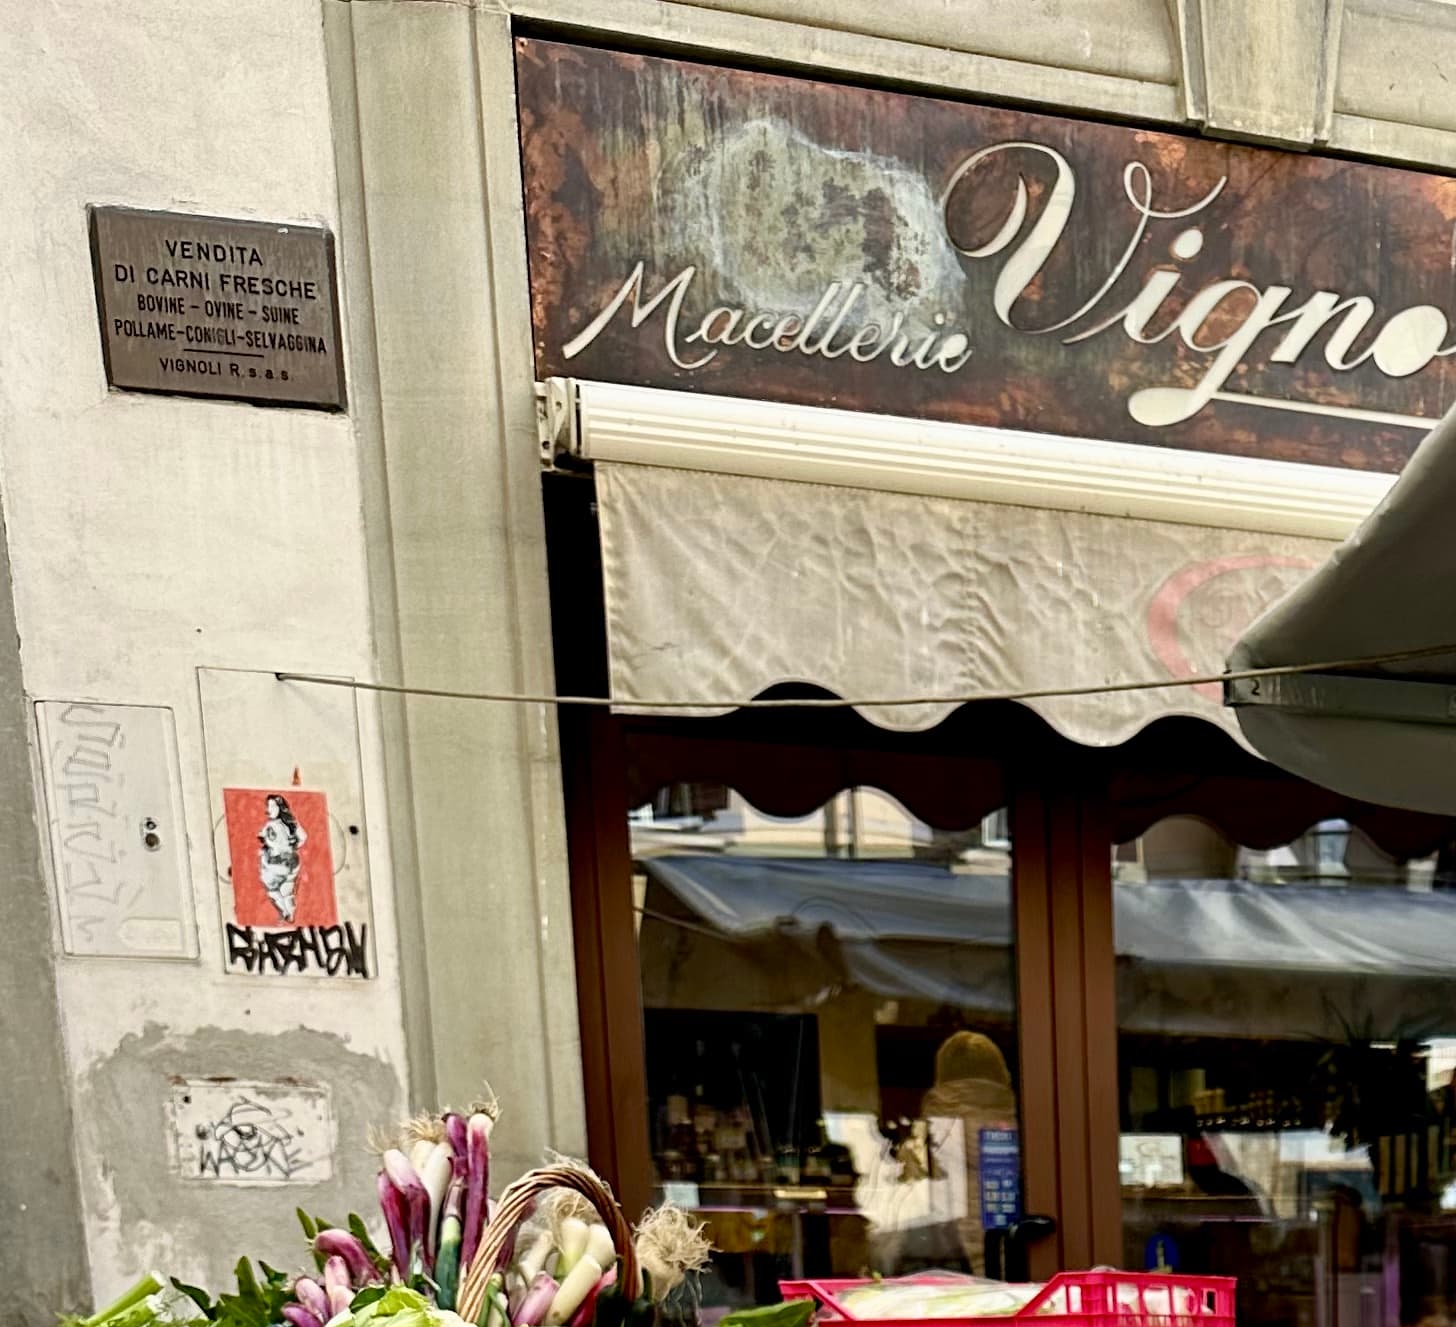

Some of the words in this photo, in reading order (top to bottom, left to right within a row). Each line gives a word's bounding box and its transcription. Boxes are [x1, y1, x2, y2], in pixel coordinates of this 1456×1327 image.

[165, 239, 264, 266] VENDITA
[114, 263, 135, 283] DI
[146, 267, 210, 290] CARNI
[220, 274, 317, 300] FRESCHE
[136, 294, 185, 315] BOVINE
[204, 300, 244, 320] OVINE
[261, 305, 299, 325] SUINE
[159, 357, 222, 376] VIGNOLI
